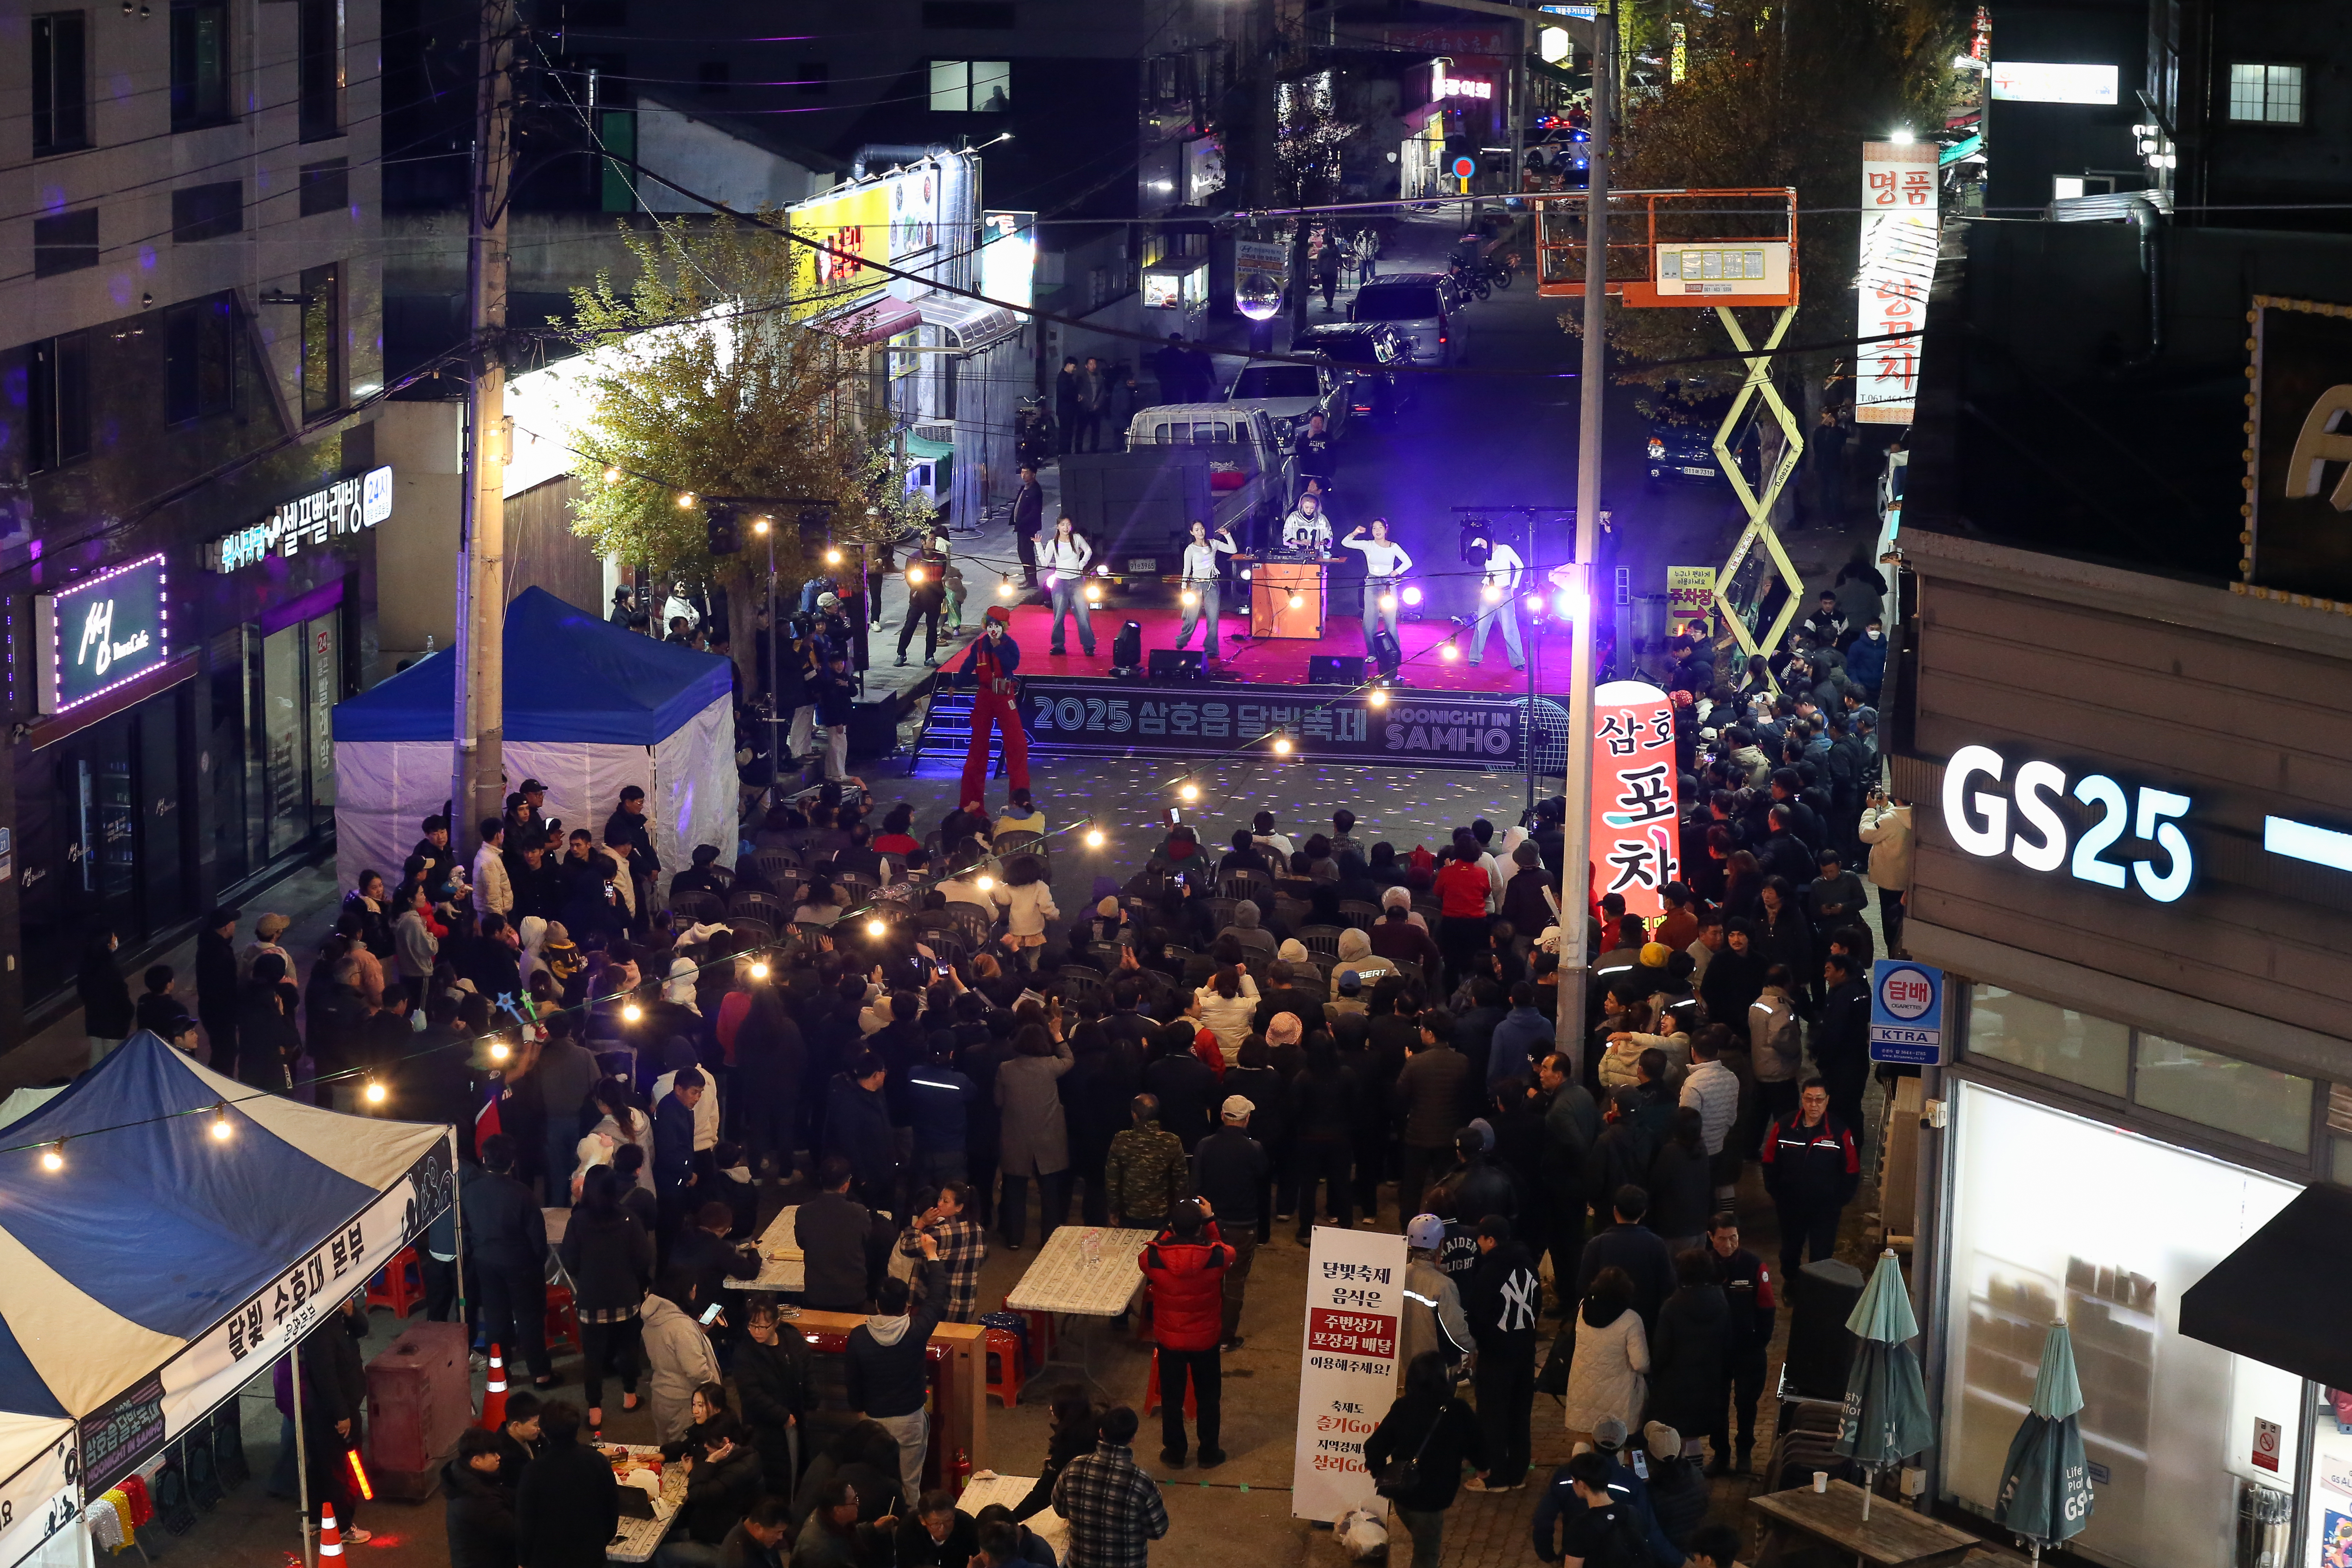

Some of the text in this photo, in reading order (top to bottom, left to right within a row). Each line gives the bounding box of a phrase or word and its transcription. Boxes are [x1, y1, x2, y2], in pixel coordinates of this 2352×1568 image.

[1868, 170, 1933, 205] 명품
[1875, 278, 1919, 390] 양꼬치
[368, 474, 388, 504] 24시
[280, 477, 362, 558] 셀프빨래방
[221, 523, 265, 574] 워시팡팡
[1669, 588, 1714, 606] 주차장
[318, 634, 327, 650] 24
[1034, 696, 1367, 742] 2025 삼호읍 달빛축제
[1386, 708, 1511, 727] MOONIGHT IN
[1596, 710, 1673, 755] 삼호
[1385, 724, 1511, 754] SAMHO
[1605, 764, 1677, 907] 포차
[1942, 745, 2192, 903] GS25
[1358, 969, 1387, 979] SERT
[1889, 981, 1928, 1003] 담배
[1882, 1029, 1928, 1042] KTRA
[1322, 1262, 1391, 1285] 달빛축제
[1446, 1257, 1475, 1272] LIGHT
[227, 1221, 365, 1363] 달빛 수호대 본부
[1331, 1287, 1383, 1308] 음식은
[1497, 1268, 1539, 1332] NY
[283, 1303, 317, 1344] 운영본부
[1324, 1314, 1384, 1334] 주변상가
[1312, 1332, 1392, 1354] 포장과 배달
[1310, 1356, 1391, 1376] 이용해주세요!
[1331, 1400, 1365, 1414] 축제도
[86, 1421, 118, 1468] 삼호읍
[87, 1419, 162, 1484] MOONIGHT IN SAMHO
[1312, 1454, 1368, 1474] 살리Go
[2066, 1465, 2082, 1479] Life
[2064, 1491, 2085, 1521] GS
